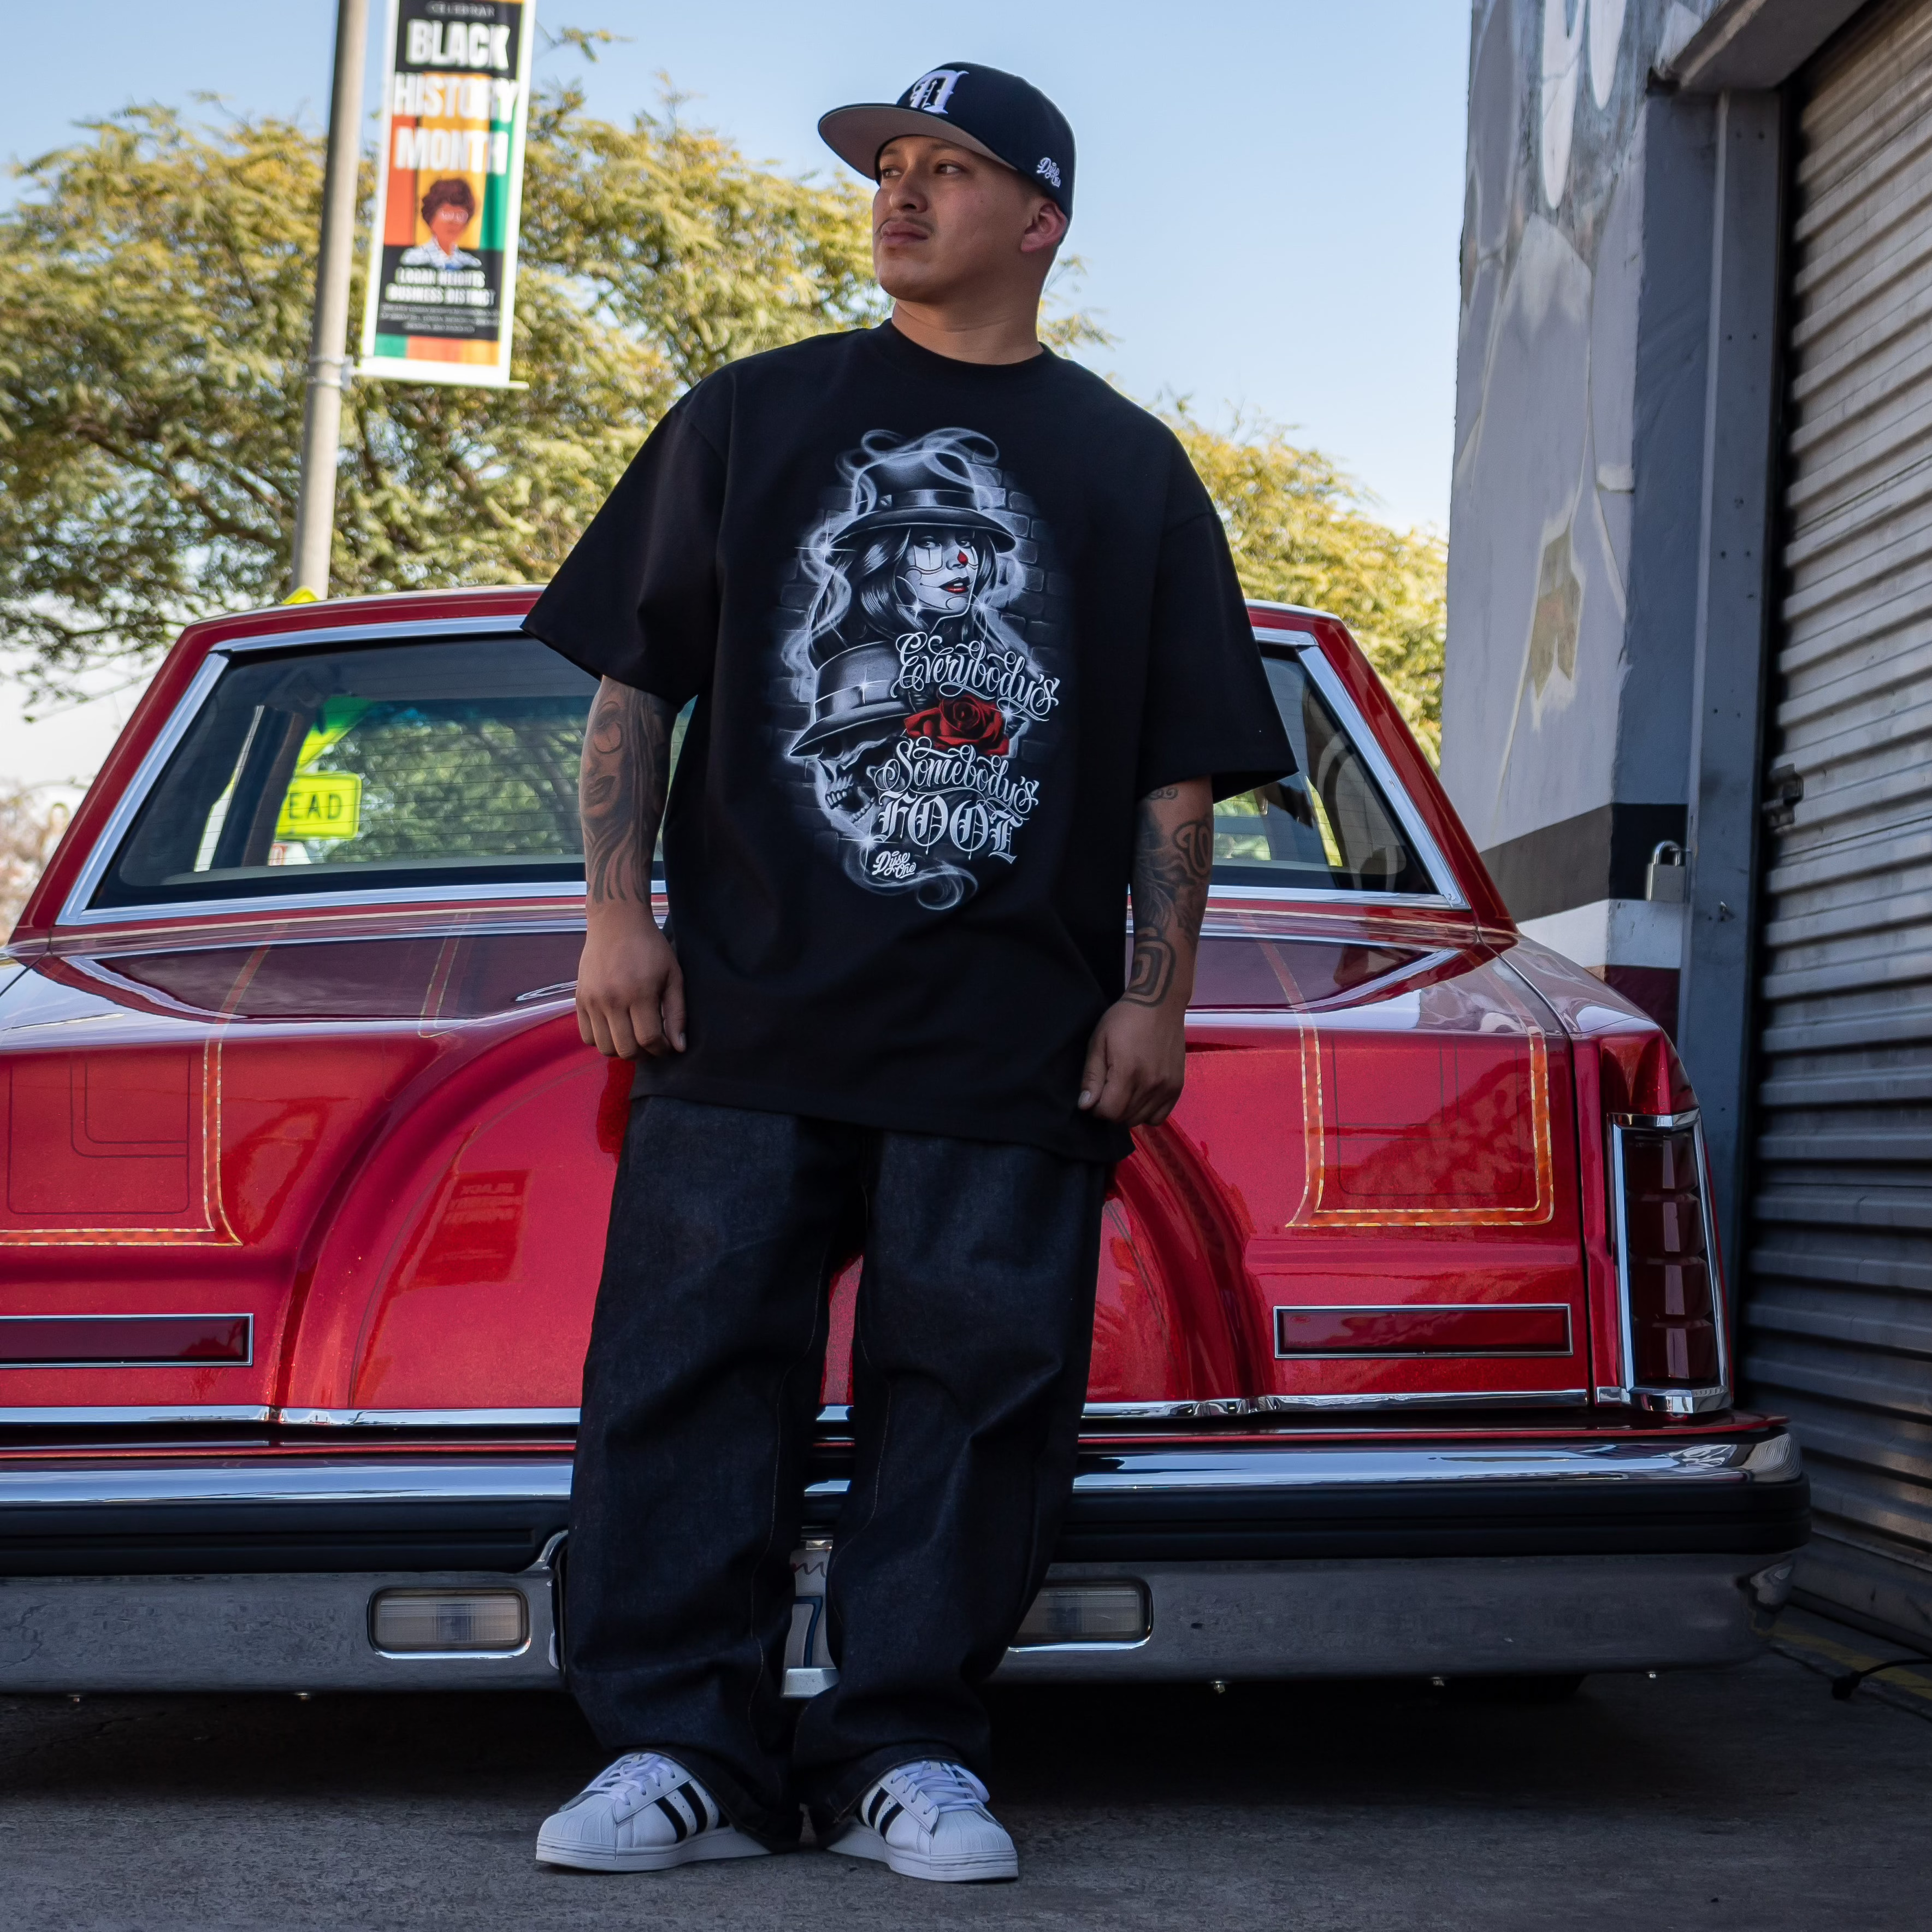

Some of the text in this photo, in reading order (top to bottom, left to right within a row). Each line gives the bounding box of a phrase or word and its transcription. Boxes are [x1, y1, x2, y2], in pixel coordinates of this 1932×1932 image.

[406, 19, 510, 70] BLACK
[890, 631, 1060, 722] Everybody's
[289, 793, 342, 819] EAD
[874, 736, 1039, 820] Somebody's
